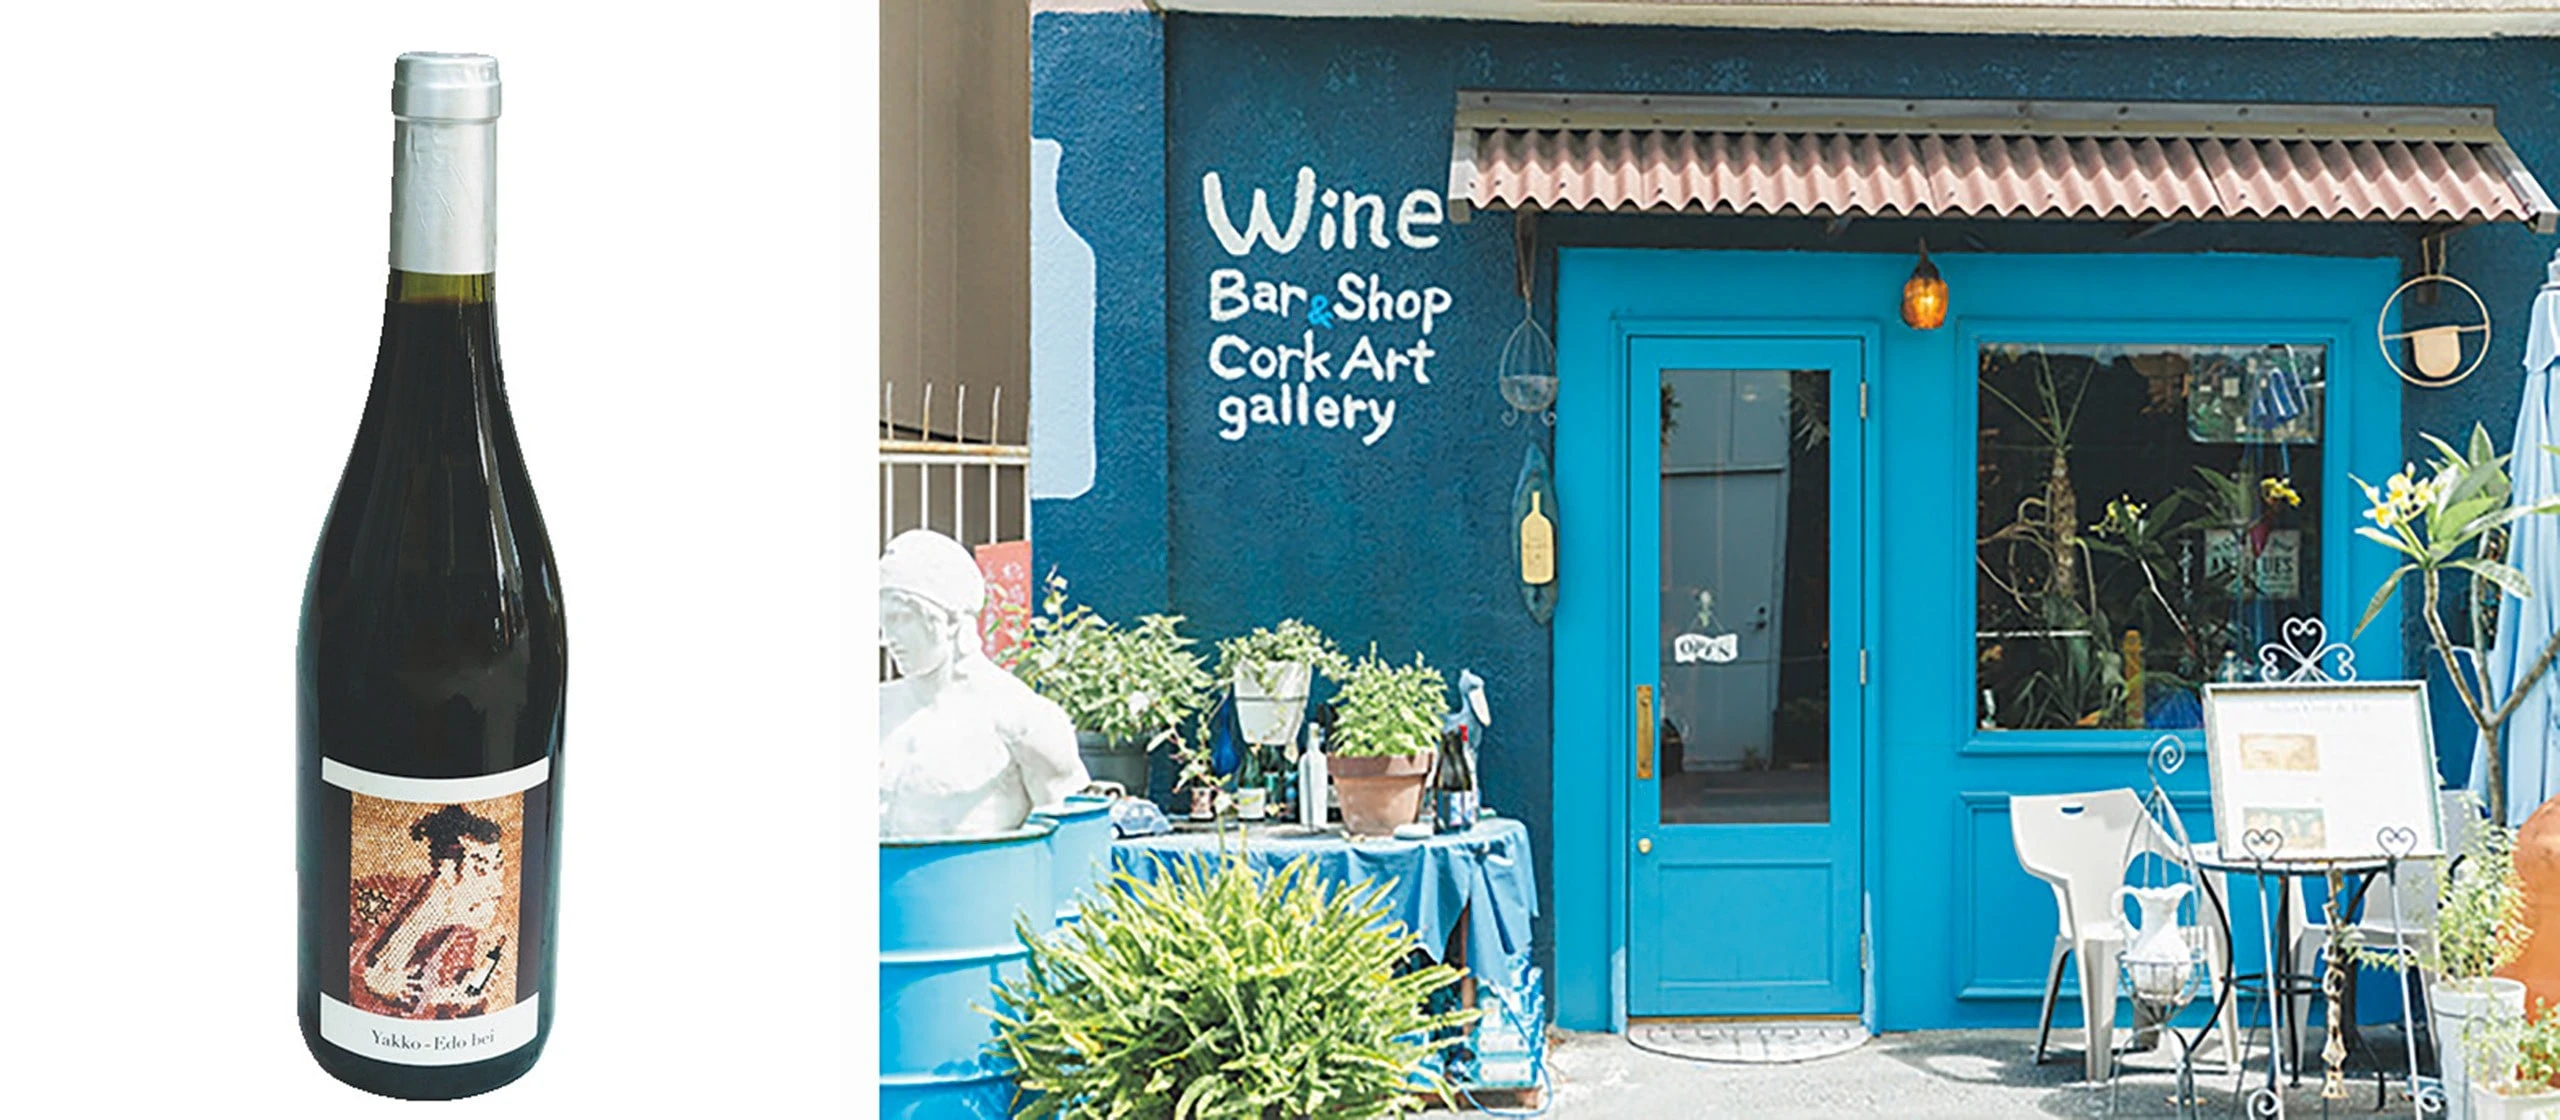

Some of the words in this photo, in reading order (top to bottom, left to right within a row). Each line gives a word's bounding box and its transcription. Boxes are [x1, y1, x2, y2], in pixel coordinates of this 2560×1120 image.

[1202, 165, 1444, 257] Wine
[1209, 268, 1308, 322] Bar
[1306, 294, 1334, 330] &
[1332, 271, 1453, 335] Shop
[1208, 329, 1332, 383] Cork
[1338, 334, 1437, 385] Art
[1217, 381, 1397, 447] gallery
[471, 1027, 496, 1047] bei
